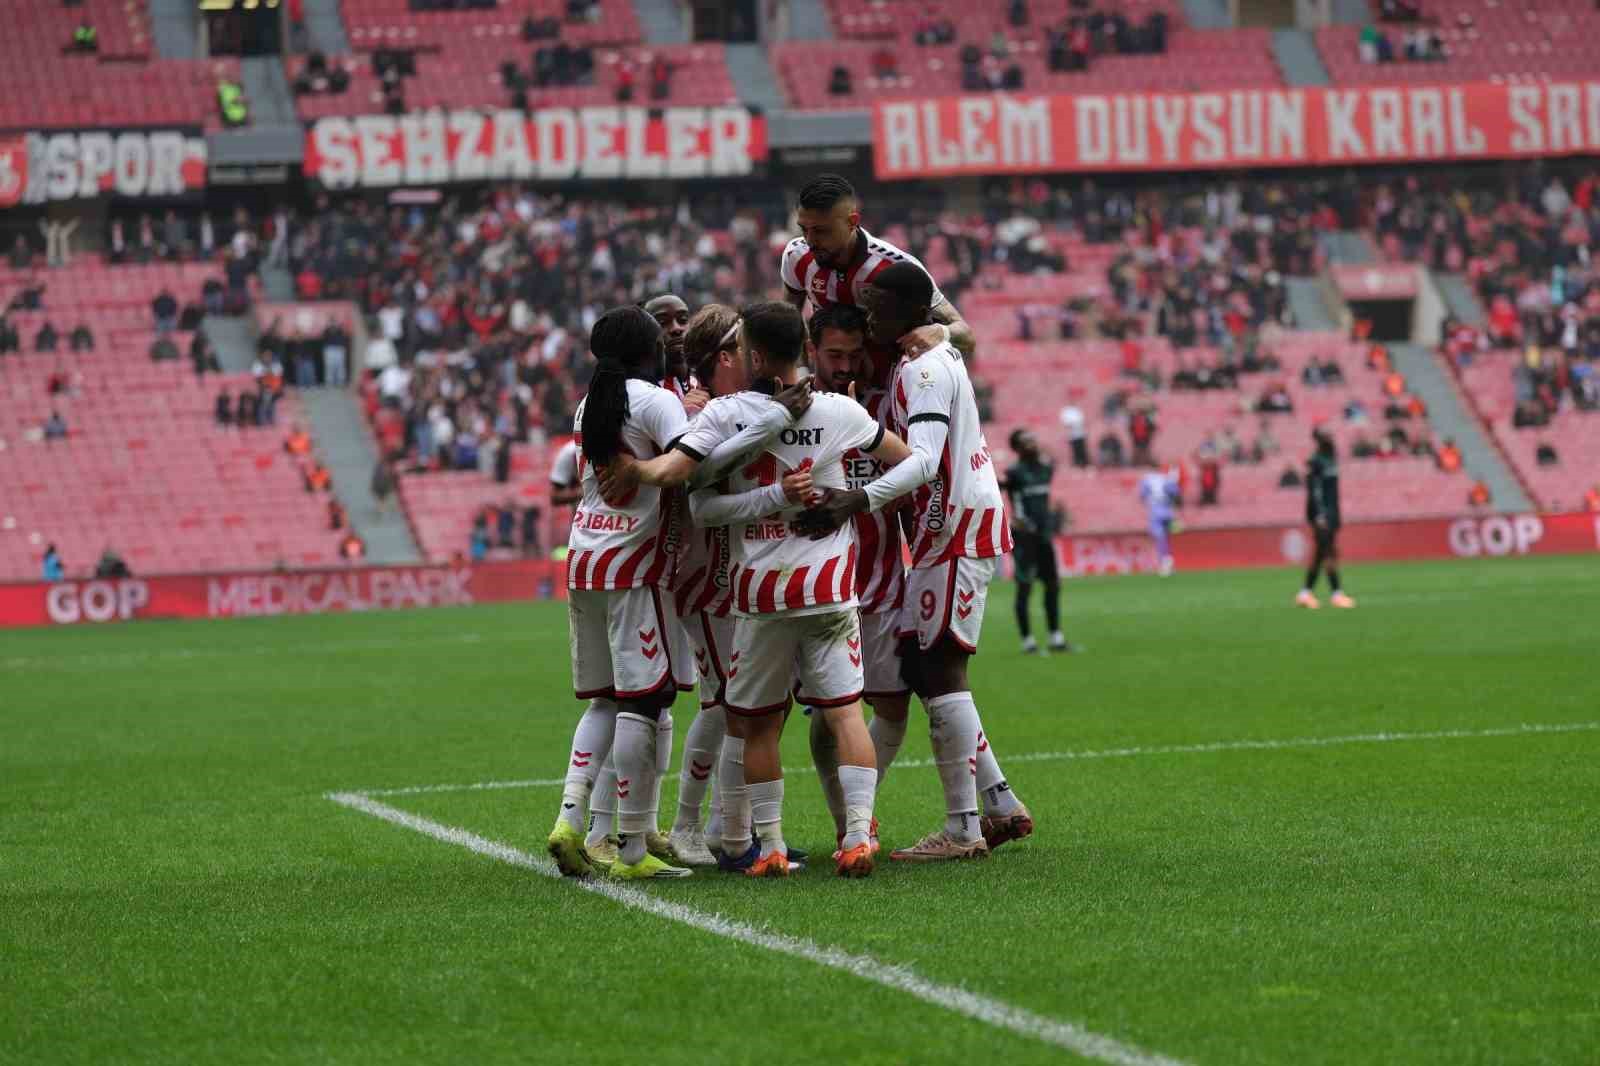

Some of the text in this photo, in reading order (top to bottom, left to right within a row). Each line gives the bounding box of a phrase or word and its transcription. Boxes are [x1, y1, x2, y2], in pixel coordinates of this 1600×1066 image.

[882, 95, 1051, 172] ALEM
[1074, 88, 1305, 163] DUYSUN
[1326, 87, 1486, 157] KRAL
[28, 131, 187, 204] SPOR
[1448, 514, 1544, 557] GOP
[46, 580, 149, 624] GOP
[920, 590, 936, 621] 9
